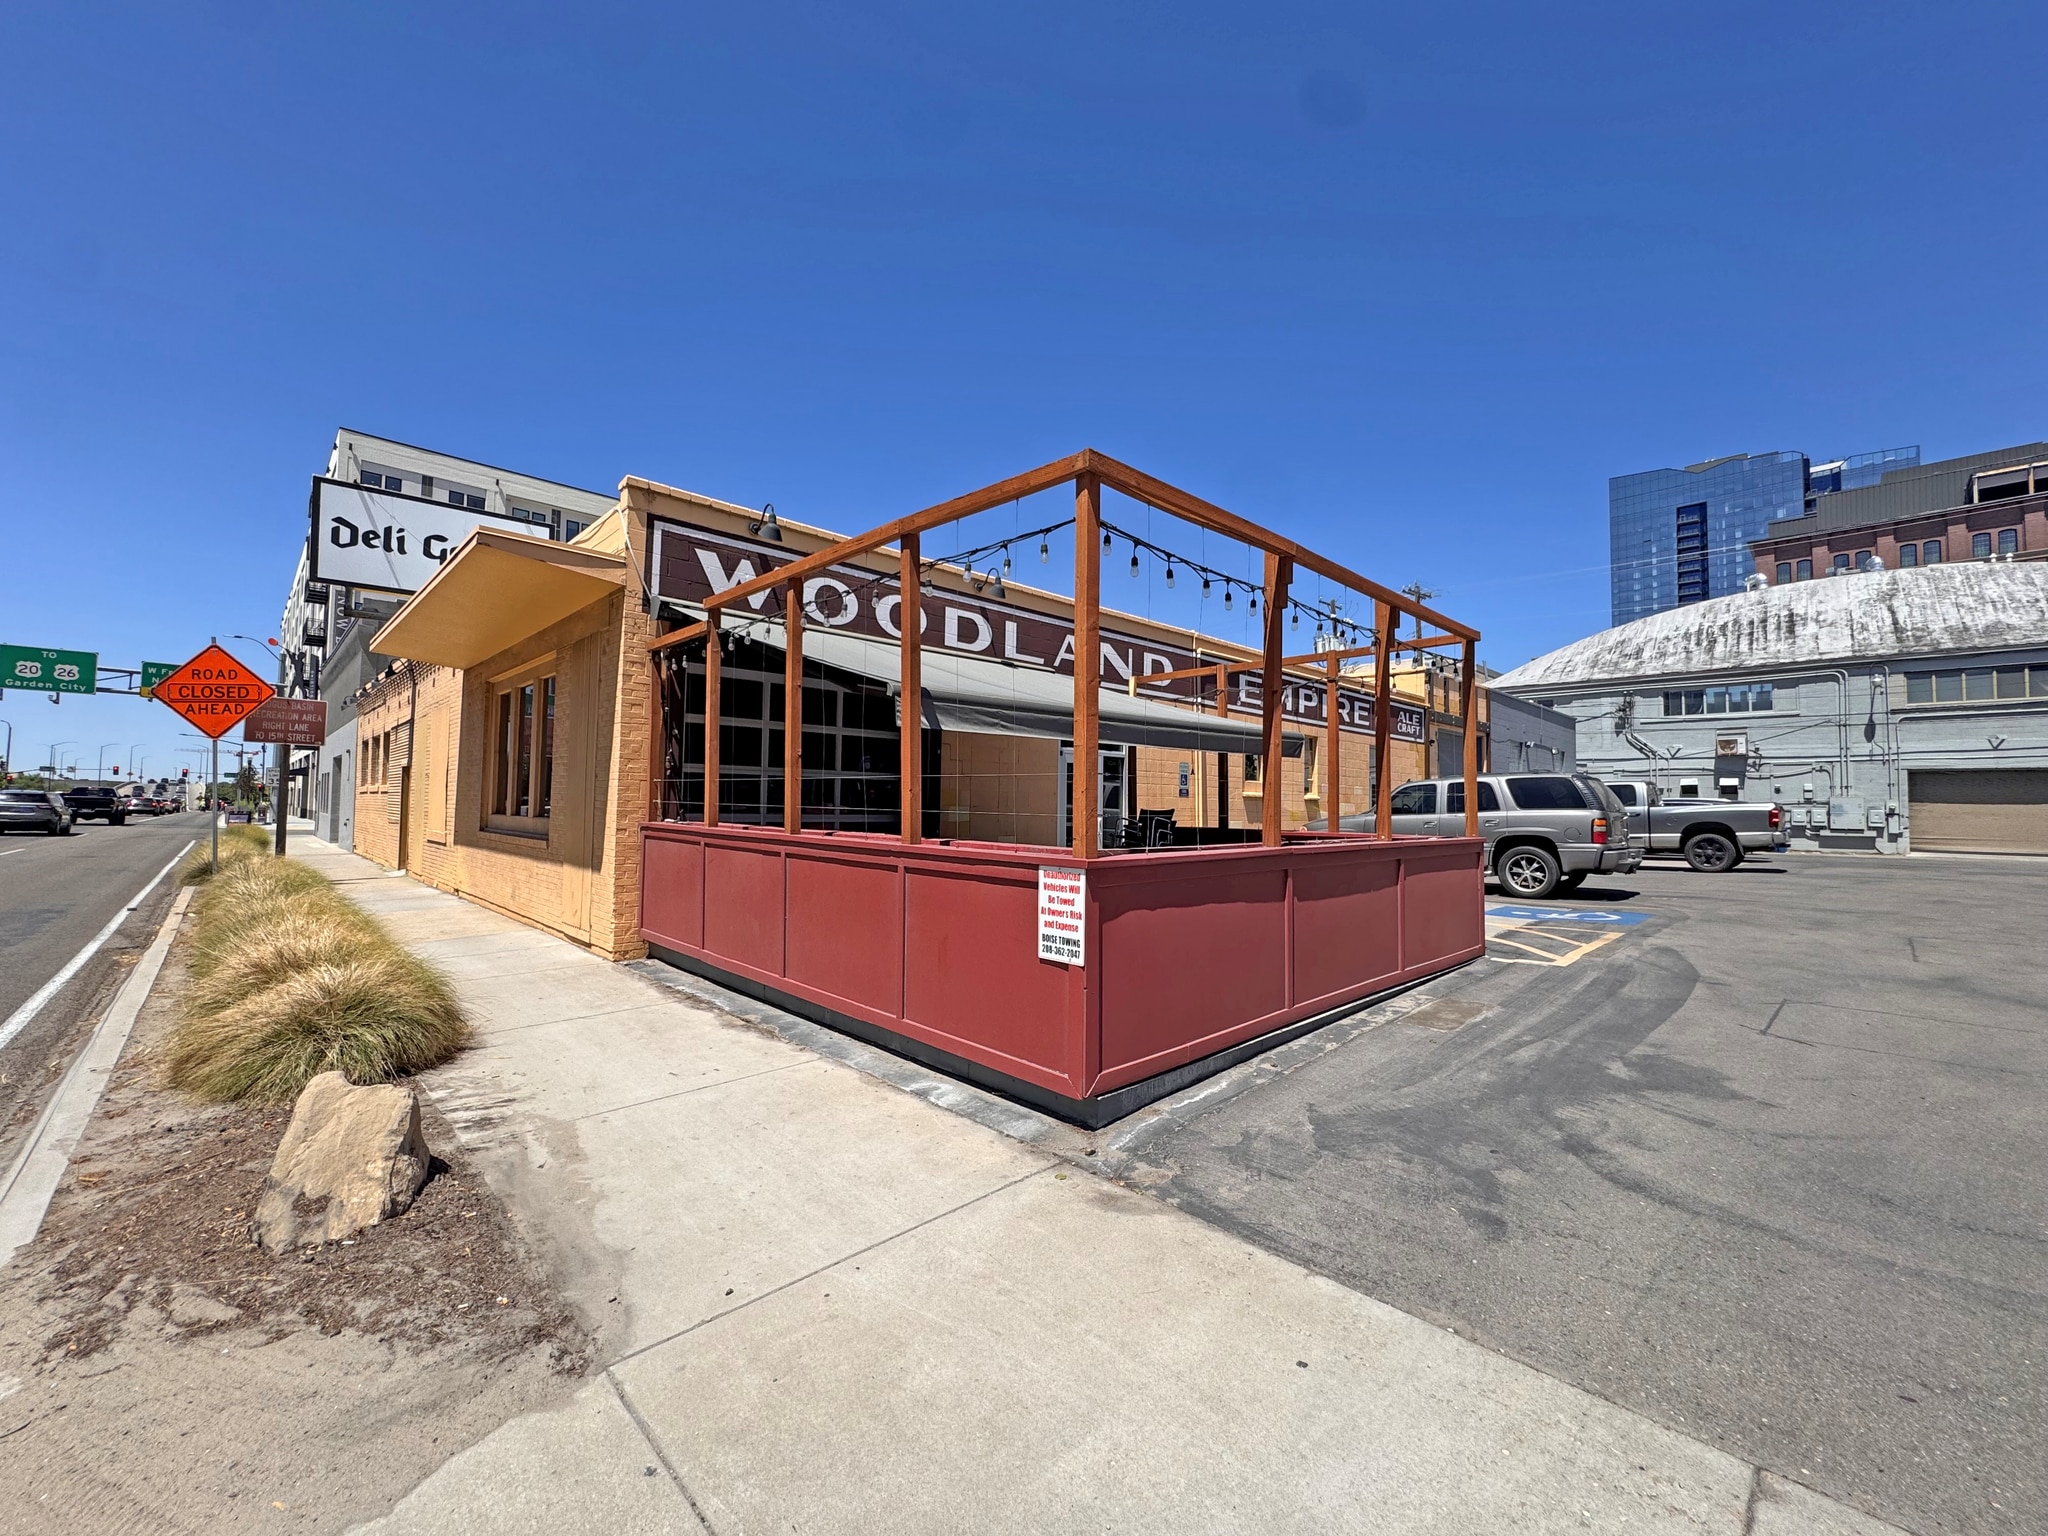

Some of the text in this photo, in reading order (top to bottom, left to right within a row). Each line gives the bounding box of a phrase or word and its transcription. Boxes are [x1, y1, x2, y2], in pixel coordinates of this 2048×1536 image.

[331, 517, 407, 555] Deli
[694, 548, 1172, 687] WOODLAND
[41, 651, 57, 659] TO
[18, 664, 76, 678] 20 26
[191, 669, 238, 680] ROAD
[5, 678, 87, 692] Garden City
[178, 685, 250, 699] CLOSED
[184, 703, 245, 715] AHEAD
[264, 700, 315, 711] OGUS BASIN
[302, 713, 322, 723] AREA
[1397, 711, 1420, 726] ALE
[262, 720, 310, 732] RIGHT LANE
[1397, 721, 1420, 736] CRAFT
[255, 731, 265, 740] TO
[268, 731, 284, 740] 15TH
[287, 733, 316, 743] STREET
[1043, 870, 1081, 882] Unauthorized
[1043, 882, 1081, 895] Vehicles Will
[1048, 895, 1075, 907] Be Towed
[1041, 906, 1047, 915] At
[1070, 910, 1083, 921] Risk
[1044, 920, 1079, 933] and Expense
[1042, 933, 1081, 949] BOISE TOWING
[1042, 944, 1081, 960] 208-362-2047
